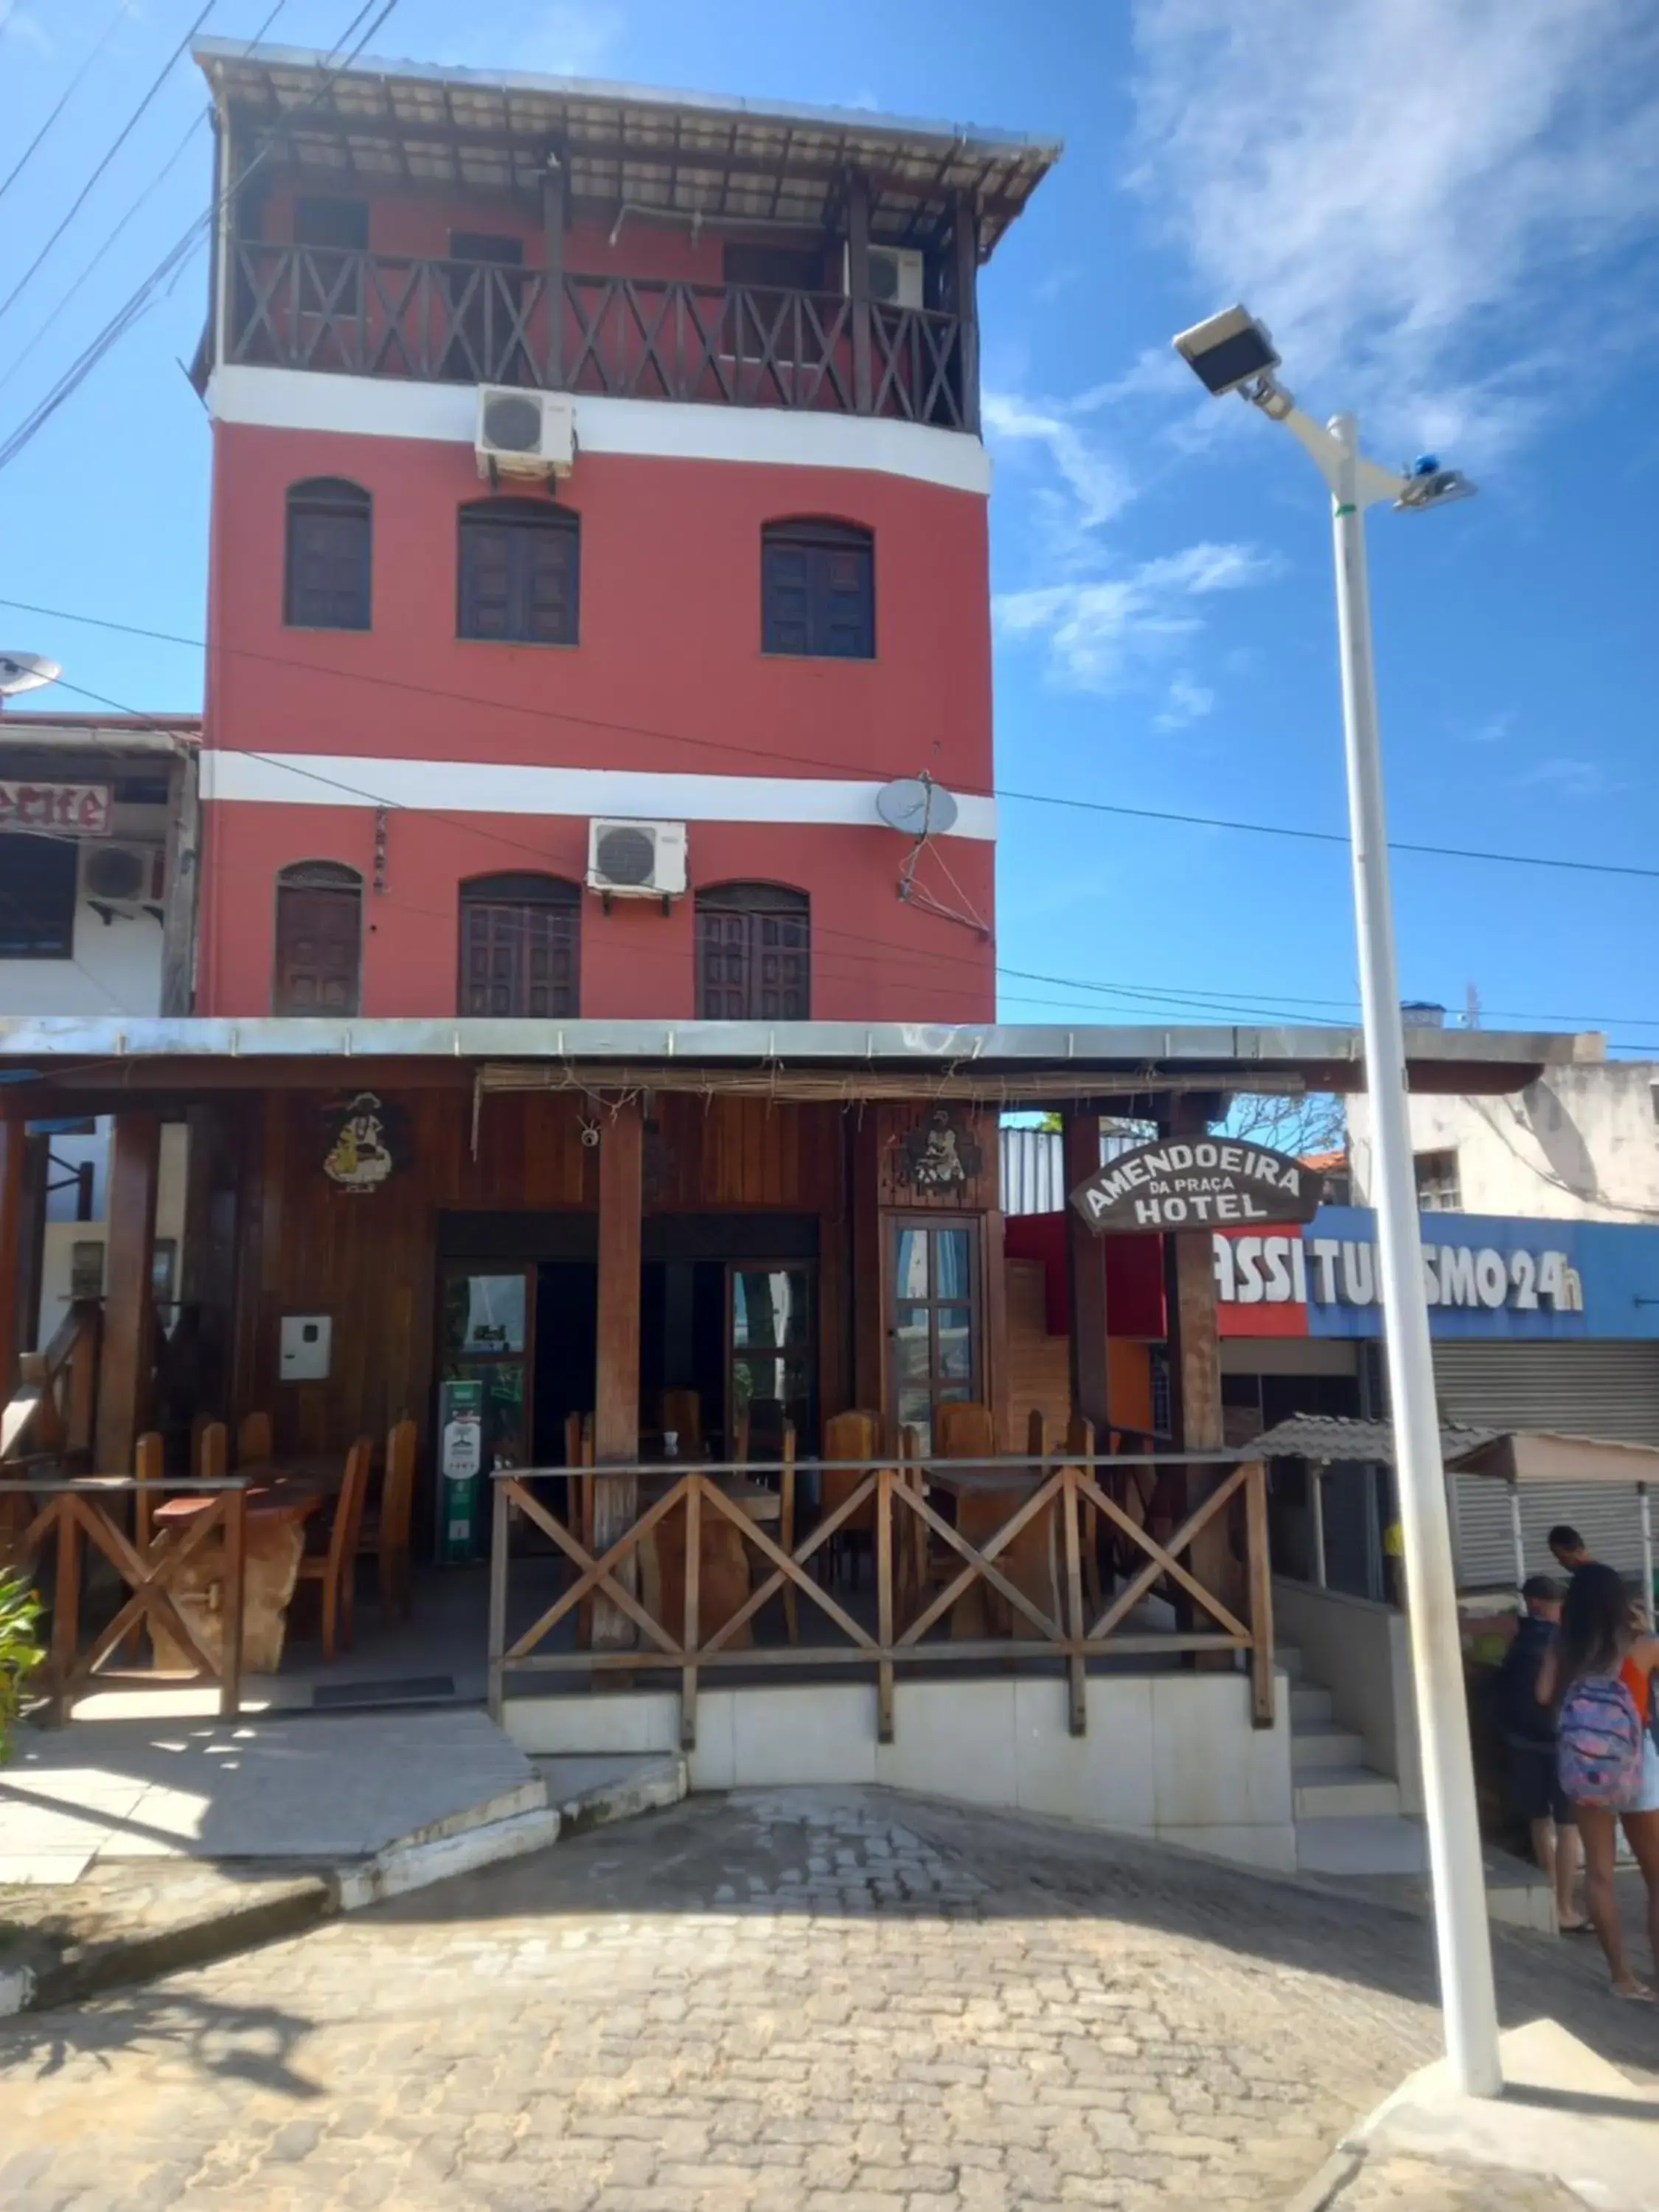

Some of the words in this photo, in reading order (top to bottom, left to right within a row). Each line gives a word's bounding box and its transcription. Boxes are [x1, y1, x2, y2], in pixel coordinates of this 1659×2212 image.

[1085, 1144, 1300, 1218] AMENDOEIRA
[1149, 1181, 1170, 1194] DA
[1175, 1177, 1235, 1192] PRAÇA
[1135, 1194, 1268, 1224] HOTEL
[1313, 1239, 1507, 1309] TUSMO
